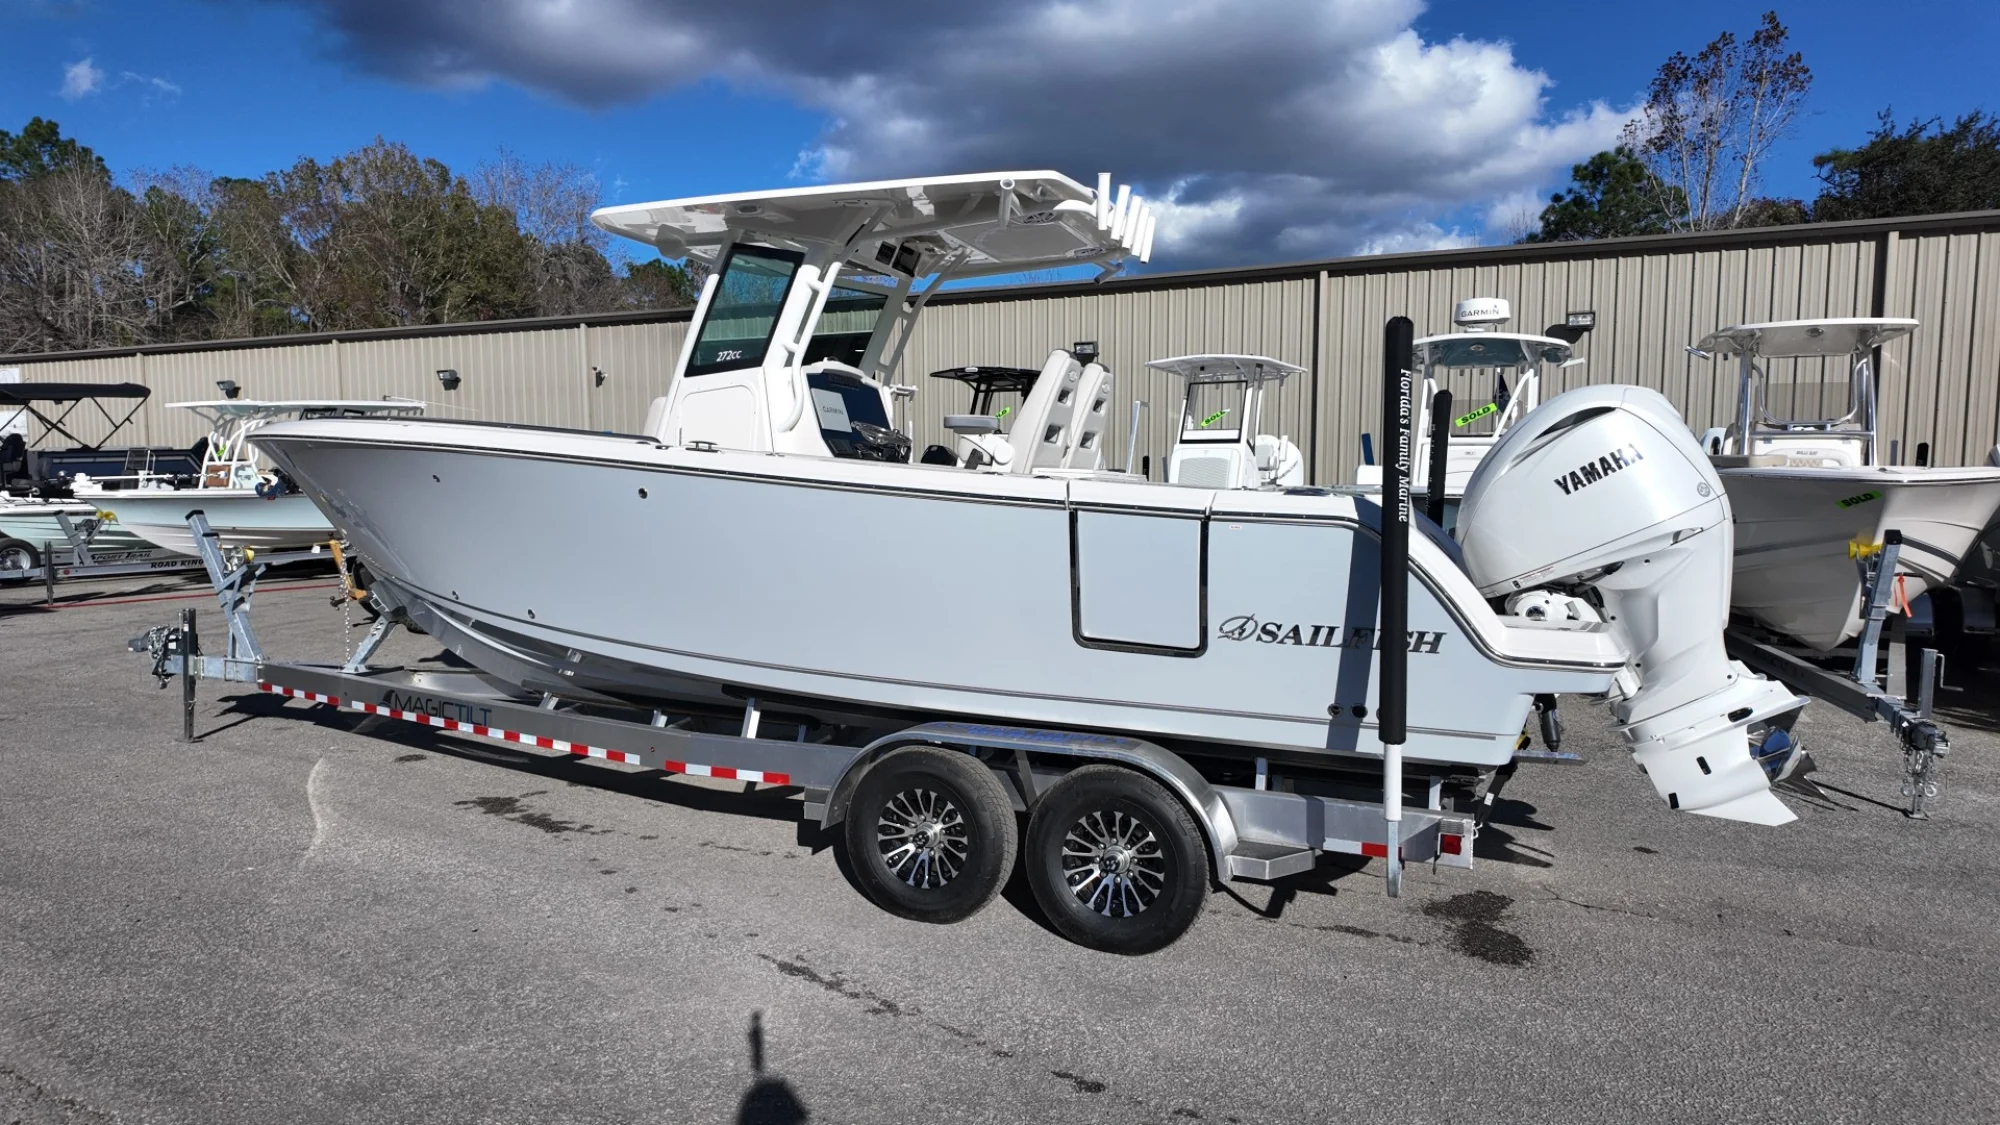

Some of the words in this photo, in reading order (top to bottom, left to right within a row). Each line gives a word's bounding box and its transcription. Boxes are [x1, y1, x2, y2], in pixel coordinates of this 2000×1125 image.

[1461, 308, 1500, 318] GARMIN
[1400, 368, 1412, 425] Florida's
[822, 405, 844, 416] GARMIN
[1460, 406, 1491, 424] SOLD
[1394, 427, 1411, 473] Family
[1553, 443, 1644, 496] YAMAHA
[1398, 475, 1411, 523] Marine
[1840, 492, 1876, 507] SOLD
[151, 560, 177, 569] ROAD
[394, 692, 493, 727] MAGICTILT
